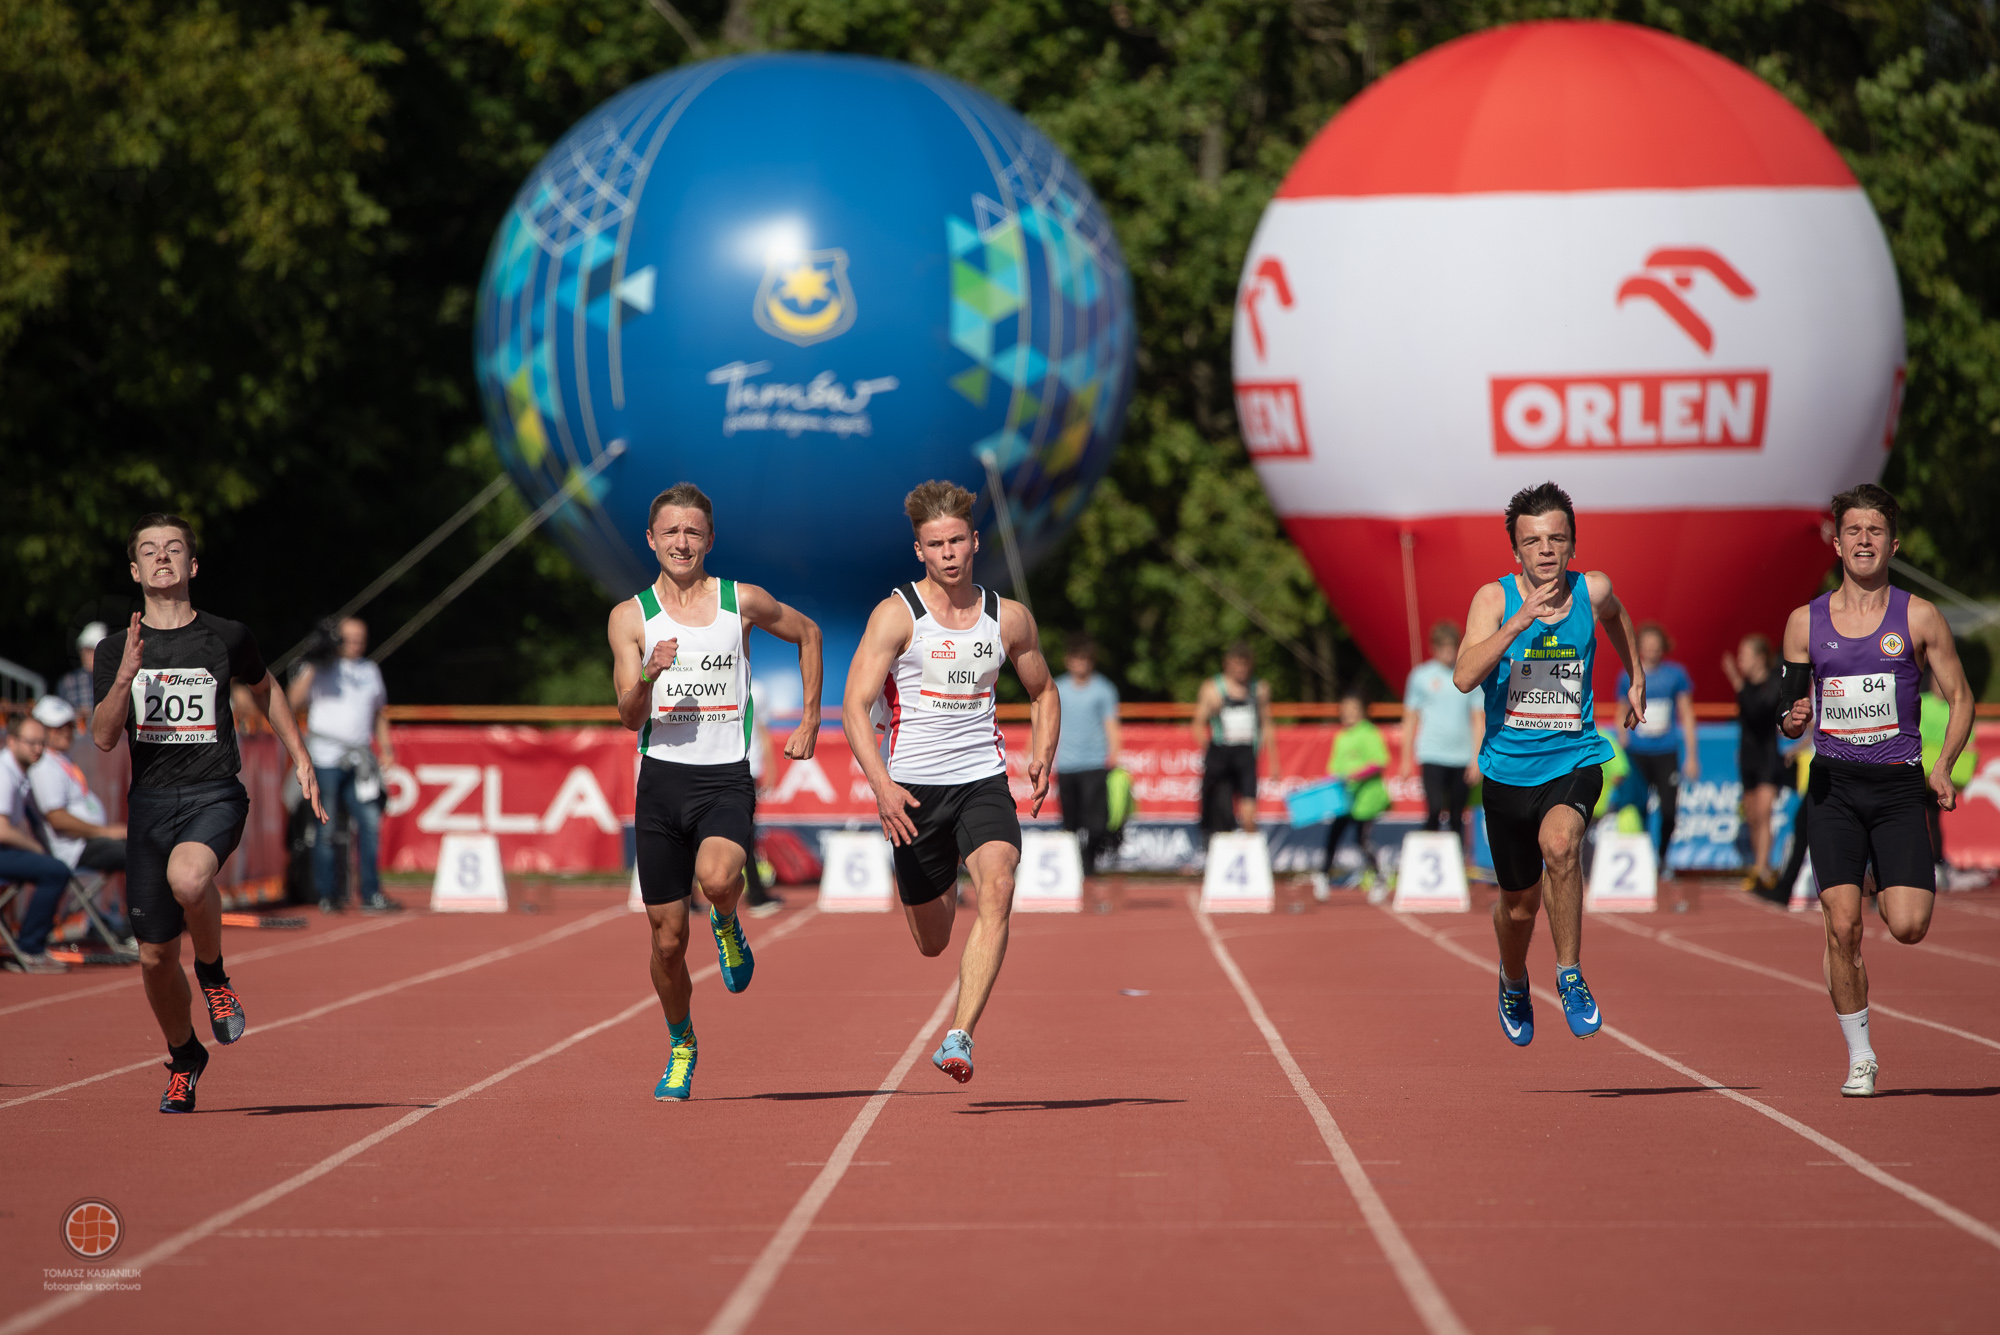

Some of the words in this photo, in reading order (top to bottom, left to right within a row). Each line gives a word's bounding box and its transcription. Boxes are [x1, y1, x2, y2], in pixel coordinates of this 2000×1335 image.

[1502, 378, 1757, 449] ORLEN
[1543, 635, 1558, 647] LKS
[973, 642, 993, 658] 34
[1524, 649, 1546, 658] ZIEMI
[1546, 648, 1576, 658] PUCKIEJ
[701, 654, 732, 671] 644
[948, 670, 978, 684] KISIL
[1549, 663, 1581, 679] 454
[666, 682, 727, 697] ŁAZOWY
[1862, 677, 1886, 692] 84
[1509, 689, 1580, 703] WESSERLING
[145, 695, 204, 722] 205
[933, 700, 967, 710] TARNÓW
[1825, 703, 1891, 720] RUMIŃSKI
[669, 712, 704, 722] TARNÓW
[706, 713, 726, 722] 2019
[1515, 719, 1552, 729] TARNÓW
[1553, 721, 1573, 729] 2019
[146, 732, 182, 741] TARNÓW
[185, 733, 205, 741] 2019
[1867, 733, 1888, 743] 2019
[456, 850, 482, 890] 8
[845, 852, 871, 889] 6
[1037, 852, 1063, 889] 5
[1224, 853, 1250, 887] 4
[1418, 851, 1445, 890] 3
[1611, 852, 1639, 889] 2
